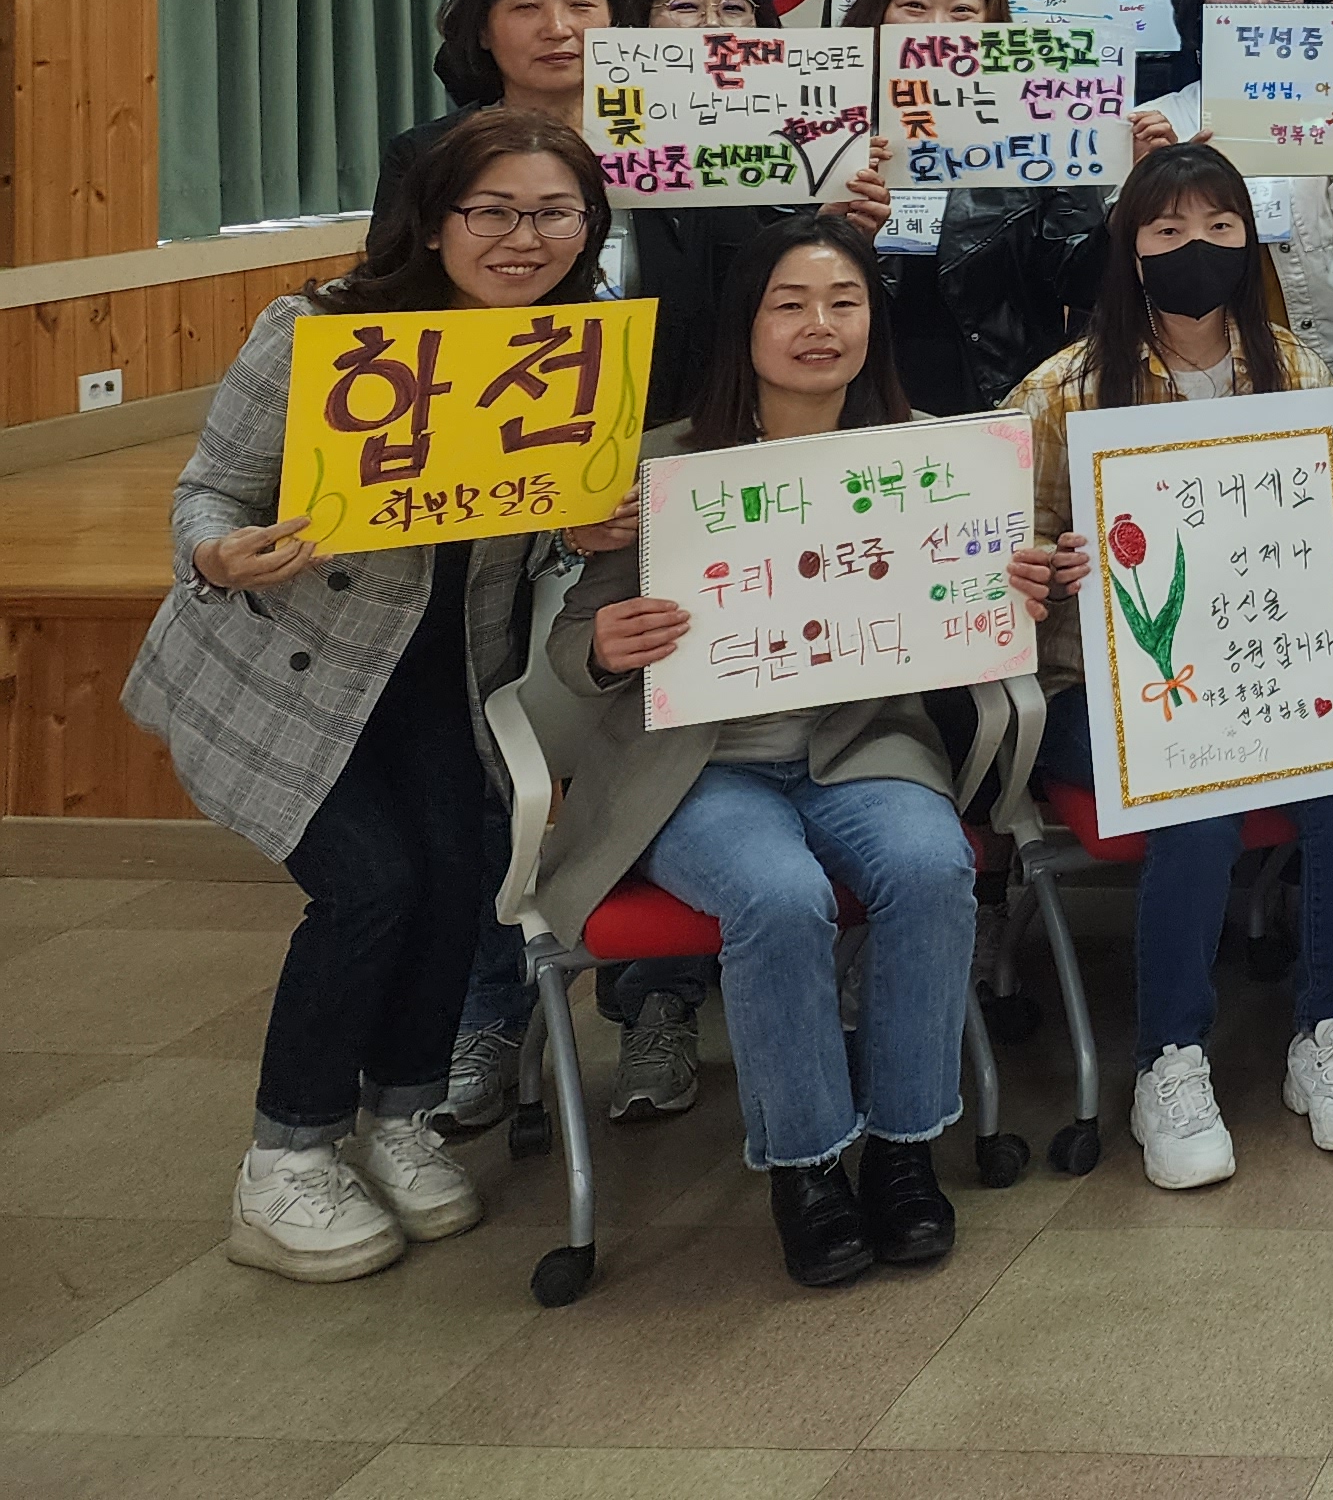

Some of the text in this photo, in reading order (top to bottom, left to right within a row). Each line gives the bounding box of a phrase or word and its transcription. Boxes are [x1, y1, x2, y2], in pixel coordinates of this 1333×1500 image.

[592, 33, 865, 90] 당신의 존재만으로도
[900, 29, 1125, 78] 서상초등학교의
[597, 85, 679, 149] 빛이
[781, 105, 873, 144] 화이팅
[889, 77, 1125, 140] 빛나는 선생님
[1270, 124, 1325, 146] 행복한
[696, 143, 798, 187] 선생님
[324, 315, 604, 487] 합천
[369, 483, 484, 532] 학부모
[692, 455, 971, 534] 날마다 행복한
[698, 511, 1031, 608] 우리 야로중 선생님들
[1228, 539, 1314, 577] 언제나
[929, 571, 1009, 605] 야로중
[1211, 588, 1289, 631] 당신을
[942, 602, 1018, 647] 파이팅
[1237, 698, 1311, 726] 선생님들
